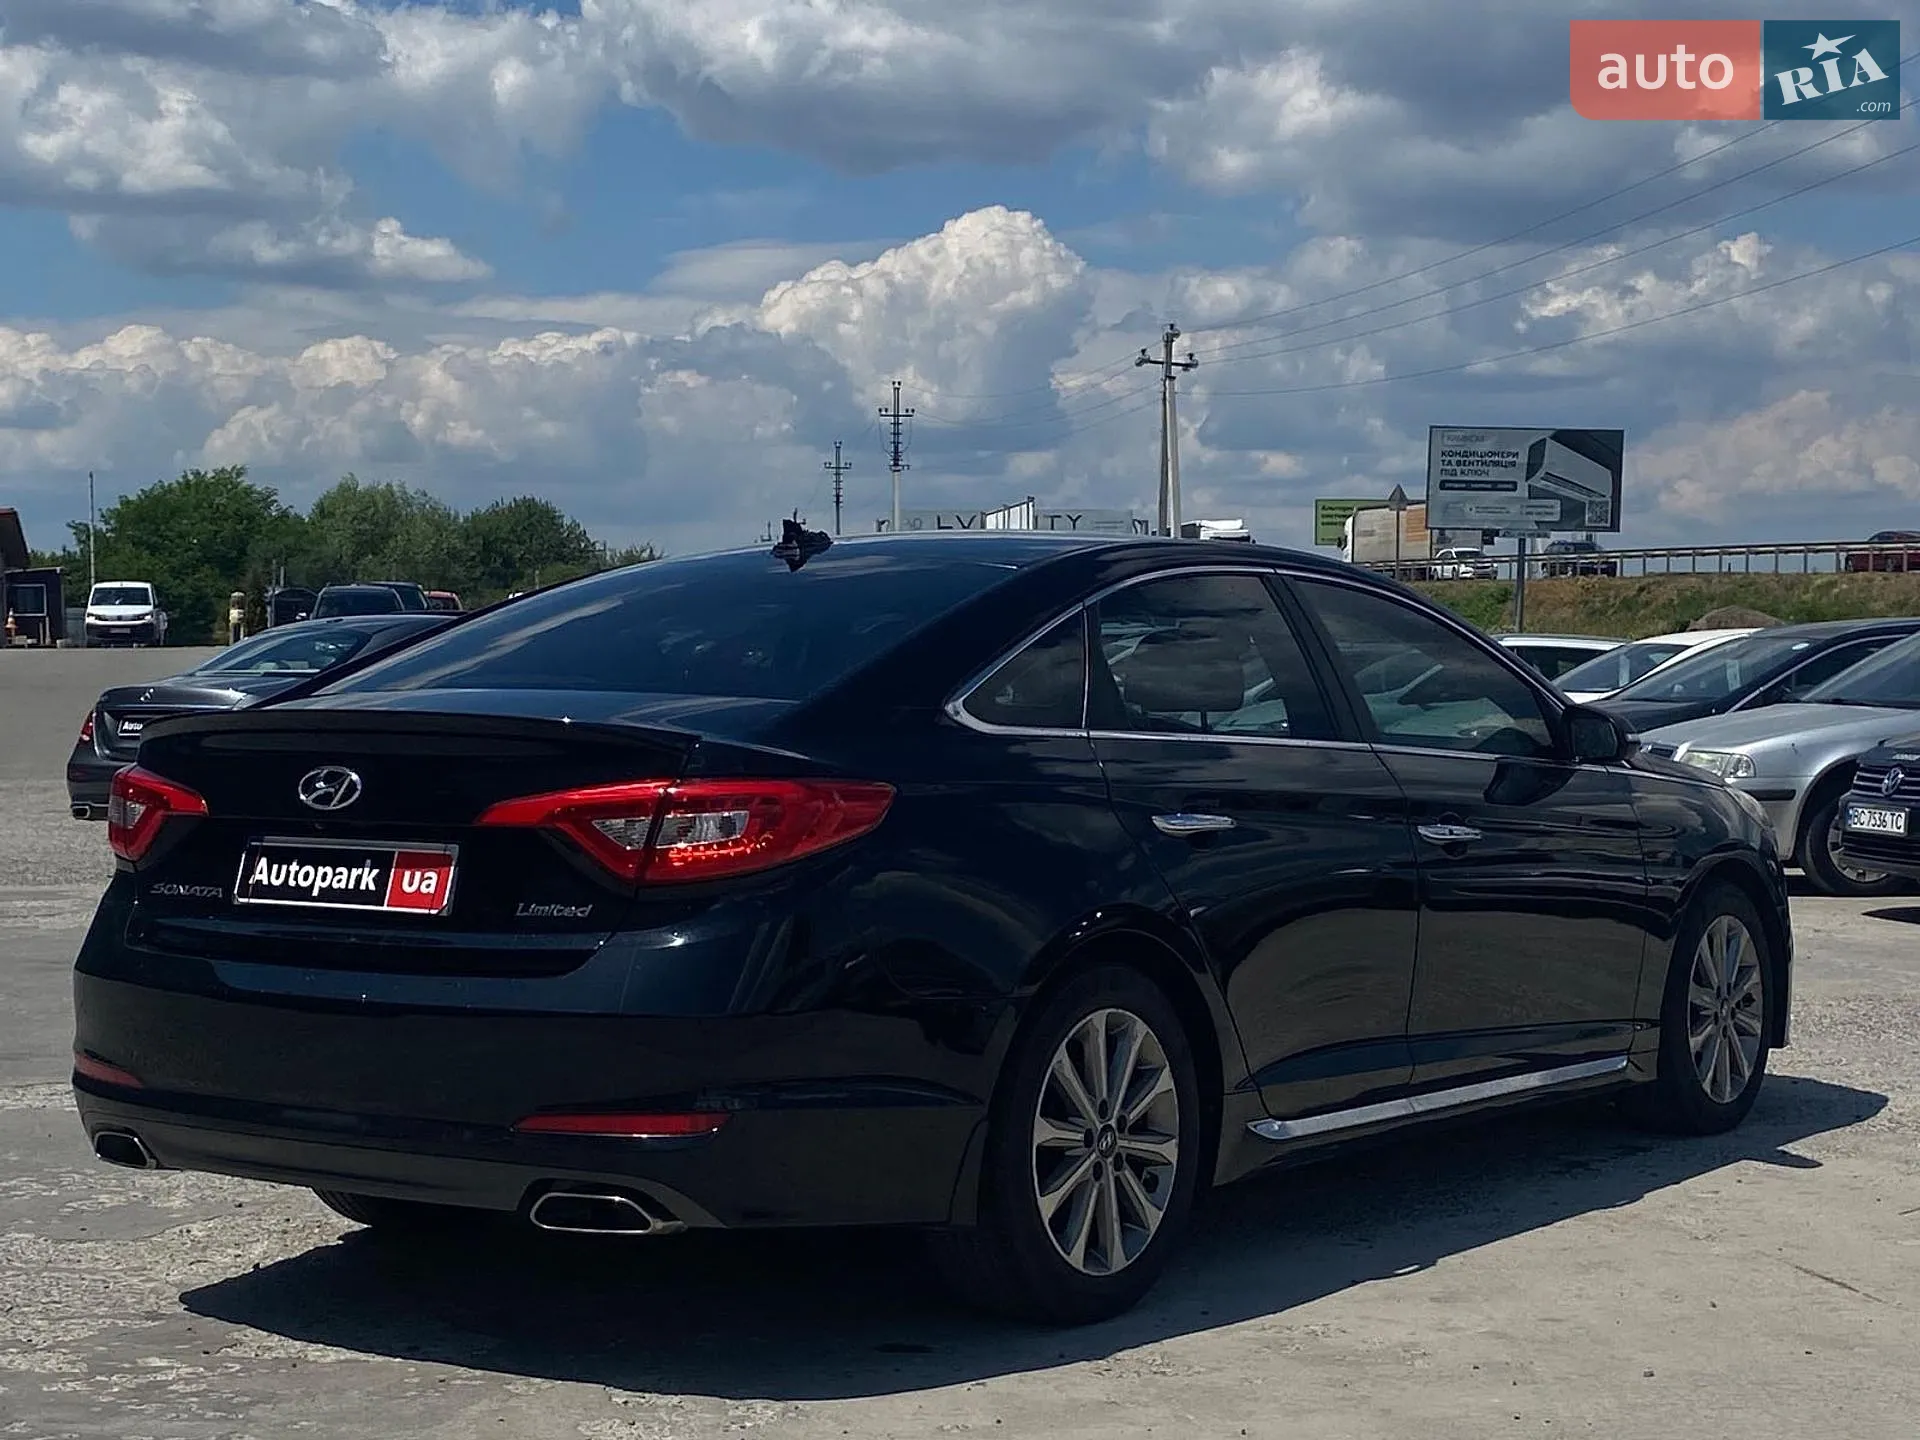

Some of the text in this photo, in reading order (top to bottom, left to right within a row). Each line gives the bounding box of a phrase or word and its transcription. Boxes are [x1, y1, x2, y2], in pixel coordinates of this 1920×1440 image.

[1440, 450, 1519, 459] КОНДИЦІОНЕРИ
[1440, 459, 1517, 469] ТА ВЕНТИЛЯЦІЯ
[122, 720, 143, 731] Auto
[1852, 809, 1903, 831] BC 7536 TC
[248, 856, 438, 897] Autopark ua
[150, 883, 223, 898] SONATA
[516, 903, 593, 918] Limited
